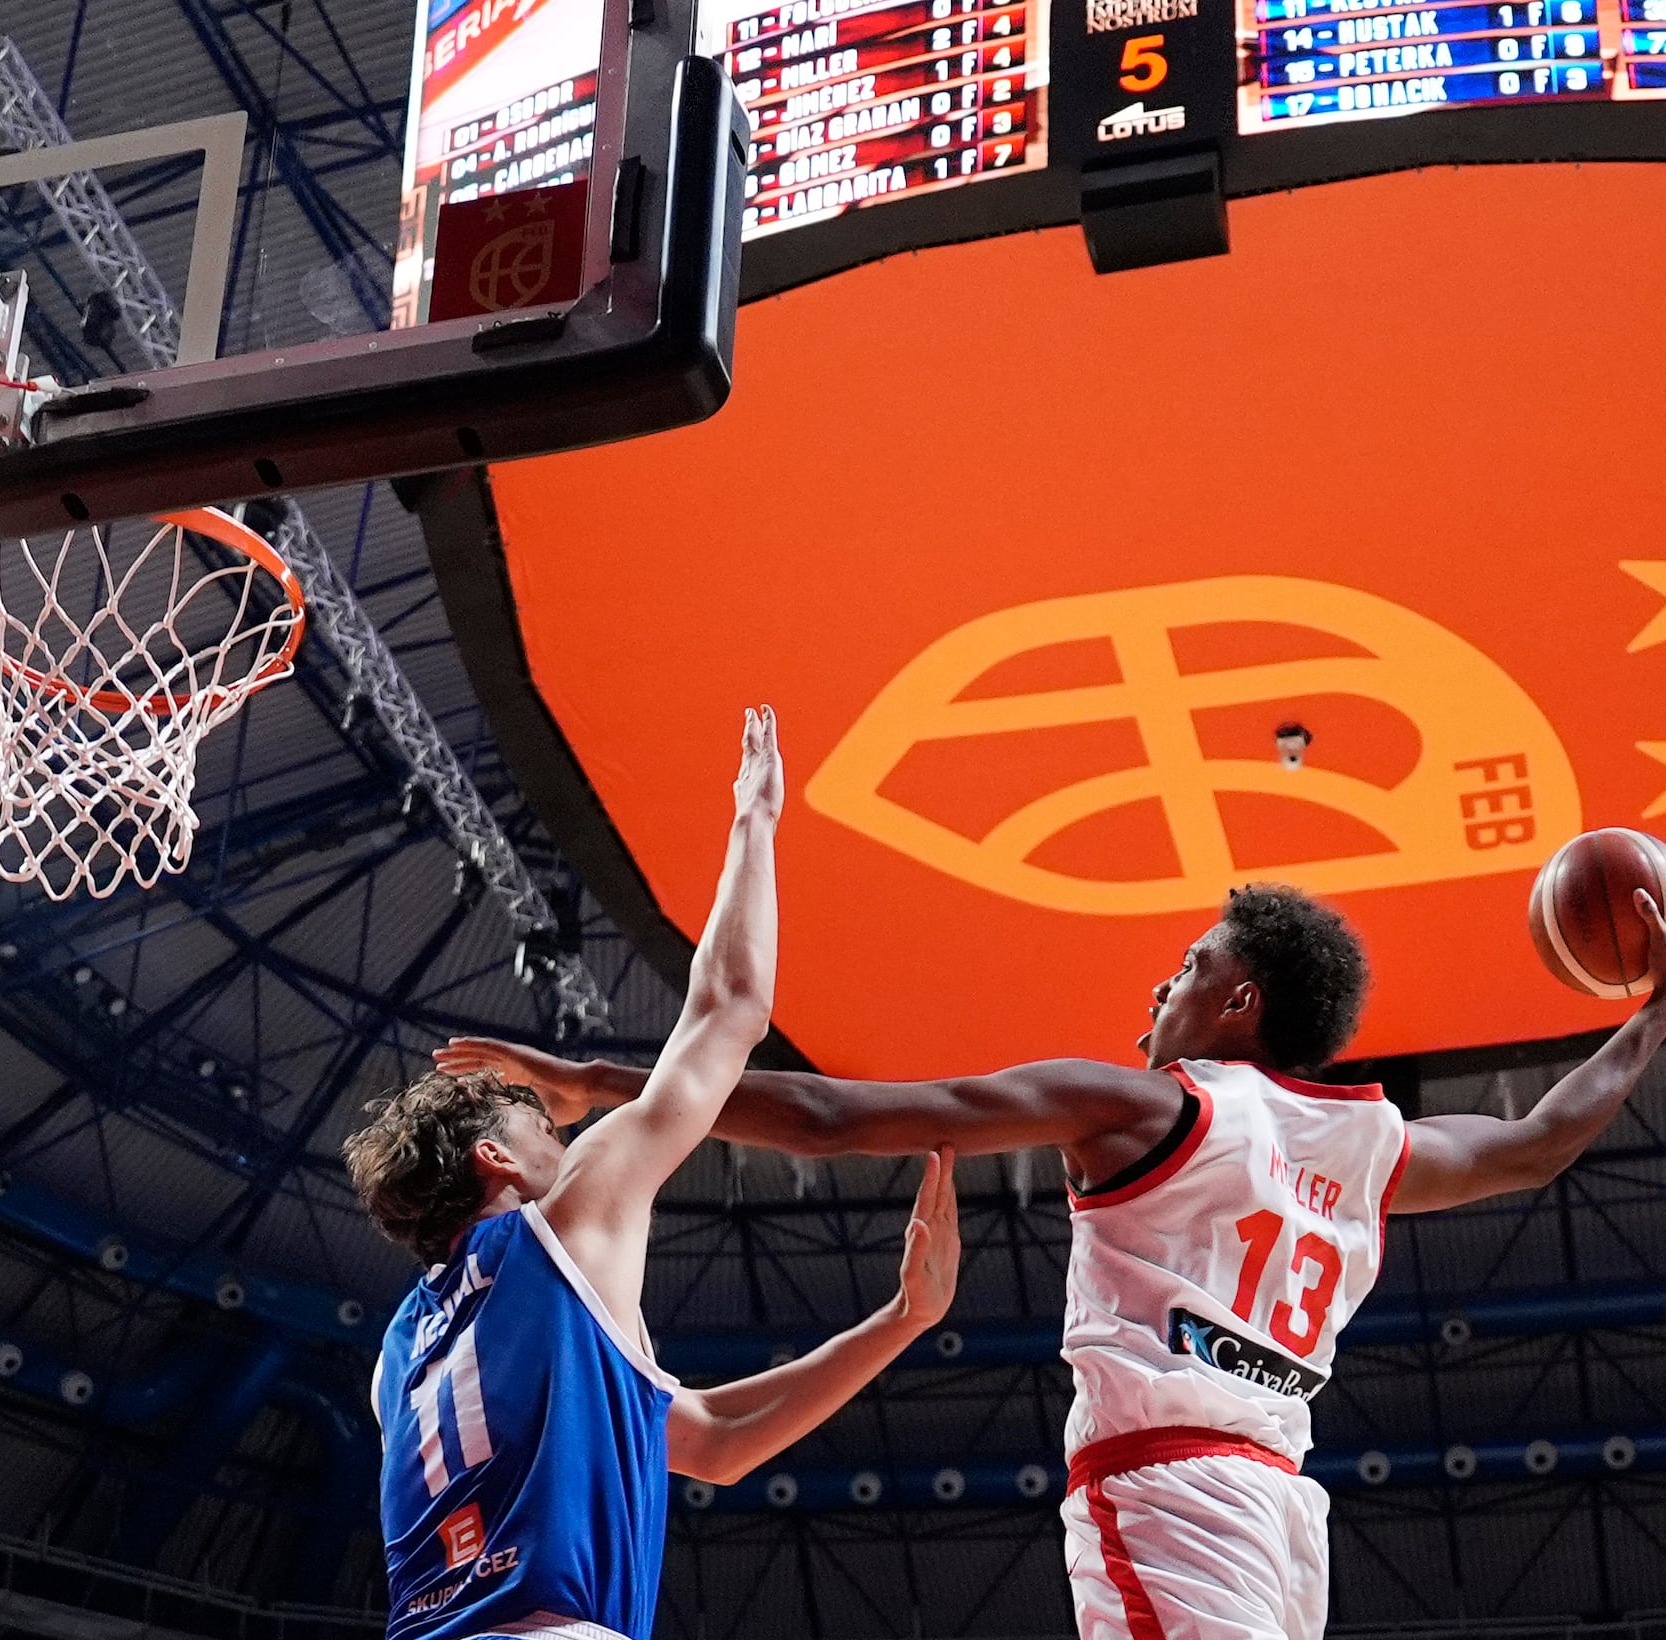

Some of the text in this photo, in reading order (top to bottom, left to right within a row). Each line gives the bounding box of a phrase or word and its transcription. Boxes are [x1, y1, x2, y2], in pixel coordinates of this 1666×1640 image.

[961, 20, 977, 43] F
[992, 15, 1011, 36] 4
[1528, 2, 1542, 26] F
[934, 60, 948, 81] 1
[961, 51, 977, 75] F
[992, 47, 1011, 68] 4
[1119, 34, 1168, 92] 5
[1339, 43, 1453, 77] PETERKA
[1531, 36, 1547, 60] F
[961, 84, 977, 108] F
[992, 79, 1011, 101] 2
[1534, 69, 1549, 93] F
[961, 116, 977, 141] F
[1097, 110, 1185, 142] LOTUS
[934, 157, 948, 179] 1
[961, 149, 977, 174] F
[994, 143, 1012, 167] 7
[1453, 752, 1537, 852] FEB
[1270, 1143, 1342, 1221] MILER
[1232, 1209, 1342, 1359] 13
